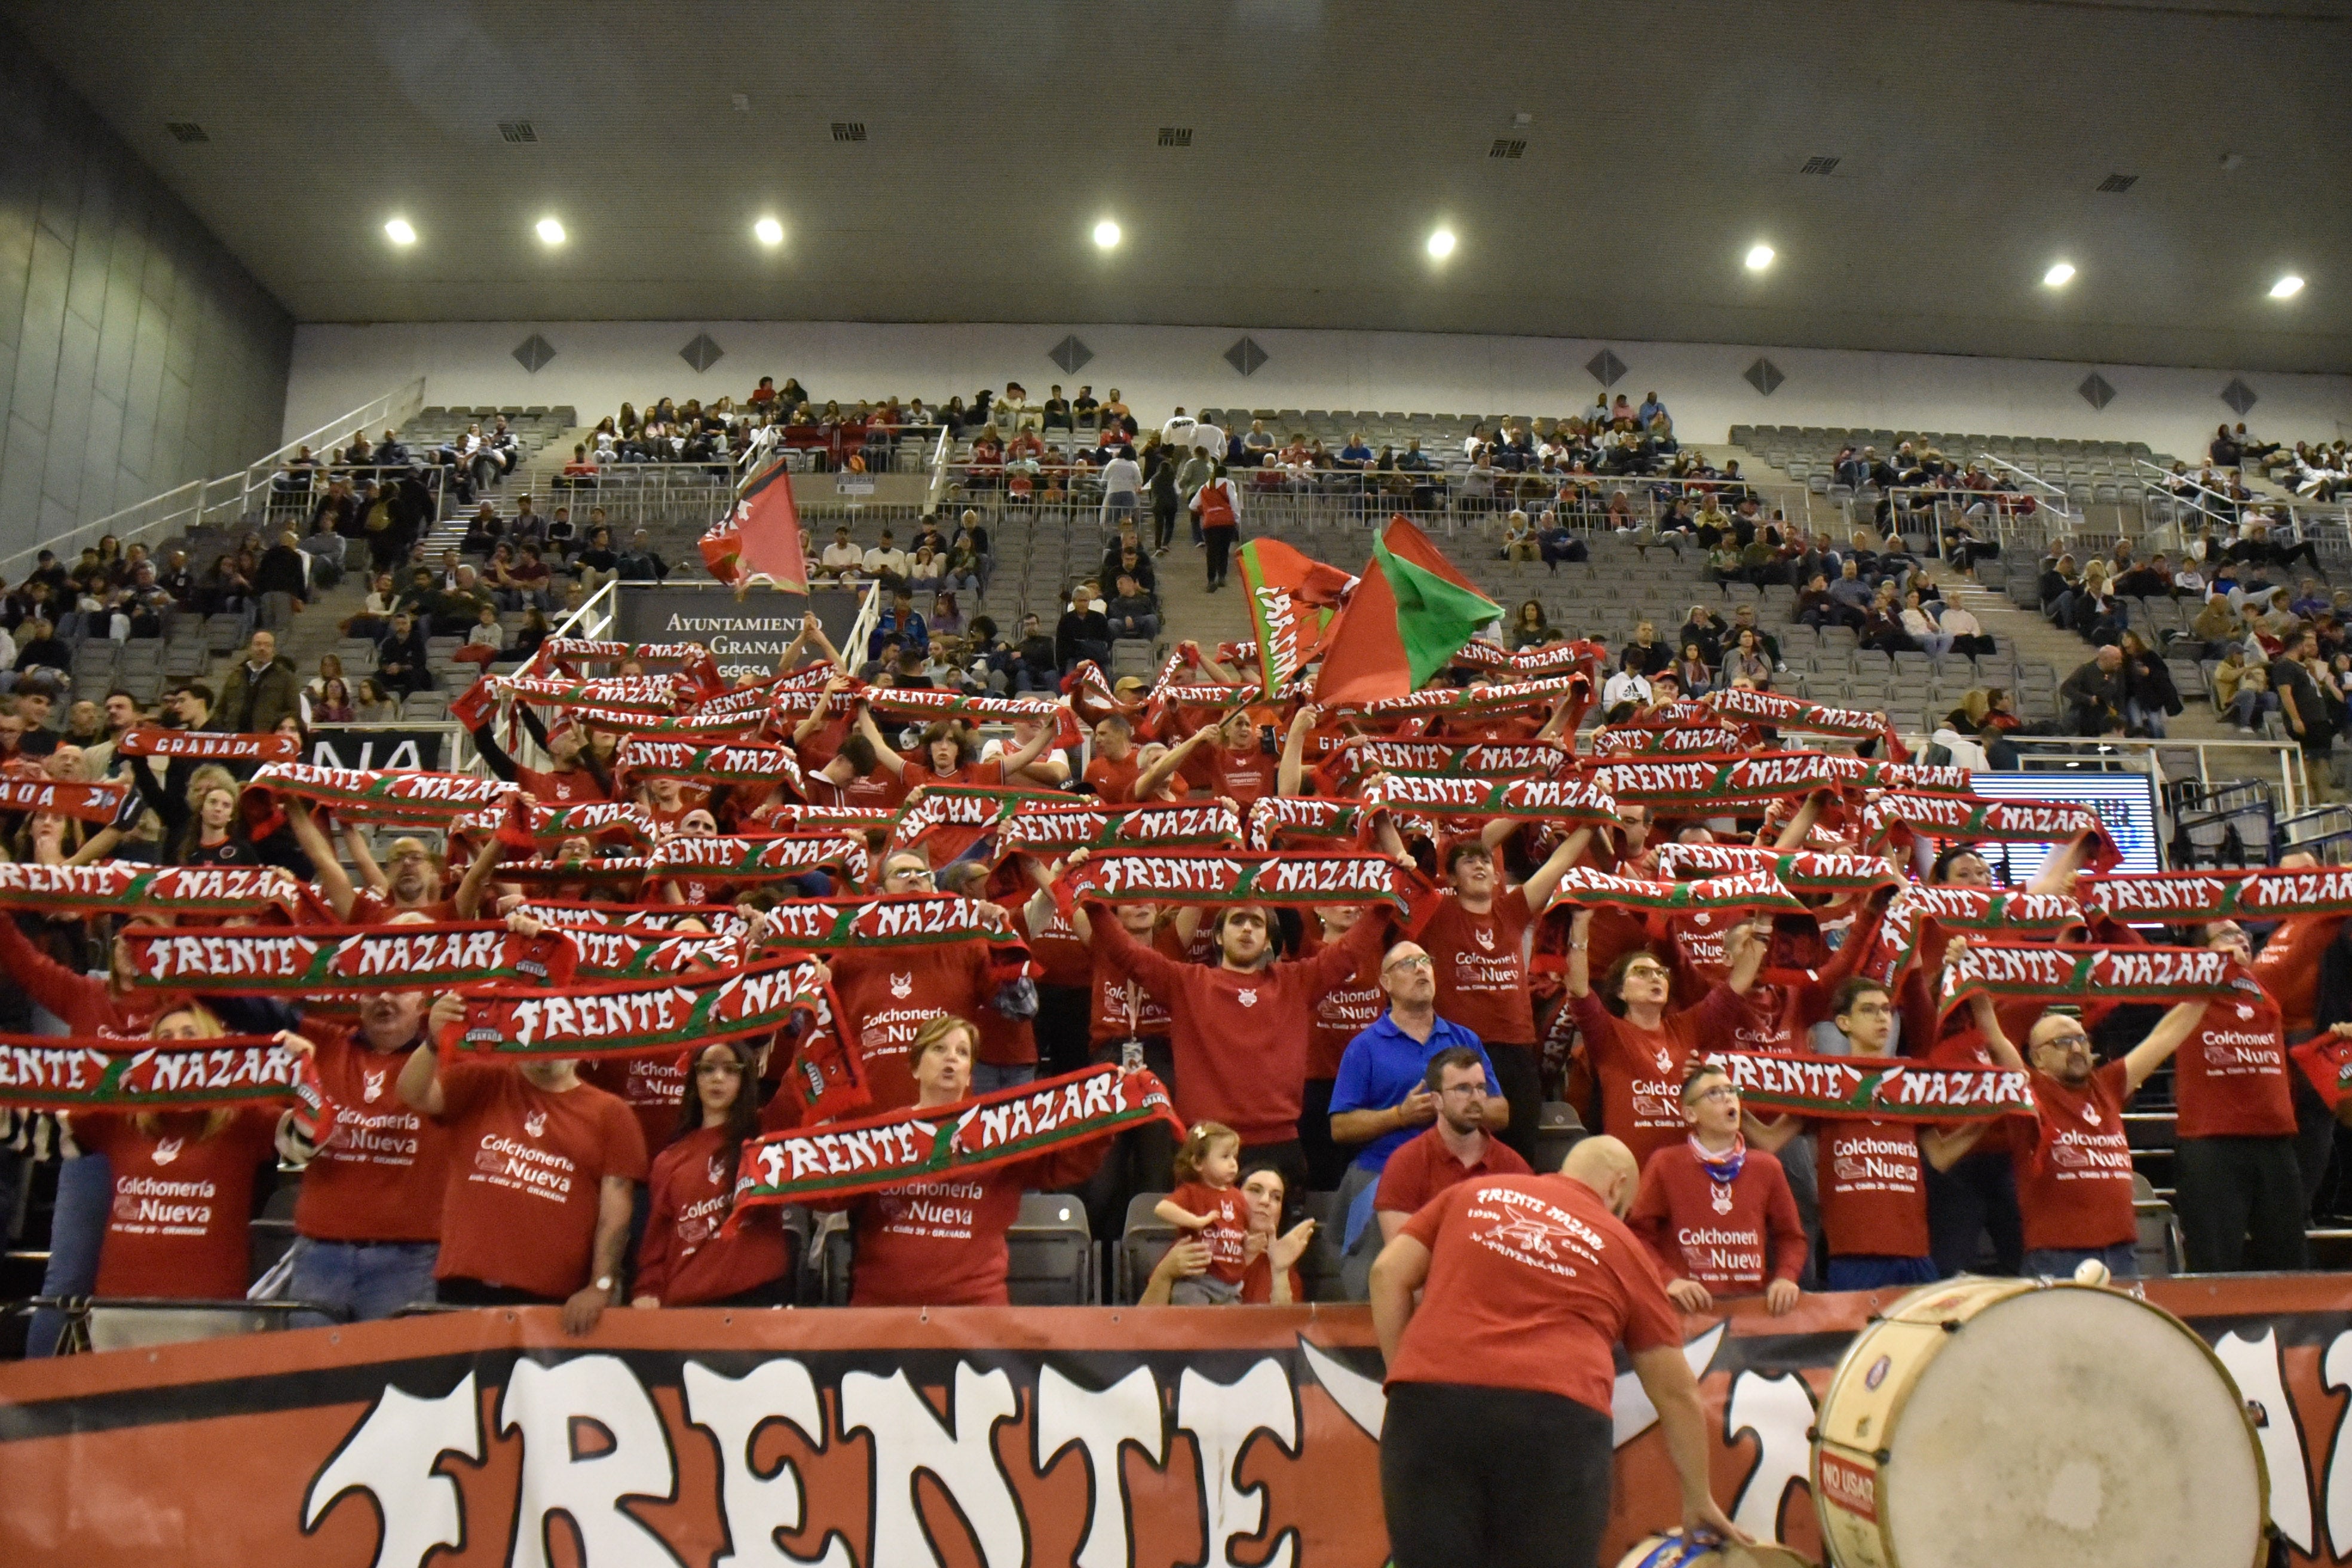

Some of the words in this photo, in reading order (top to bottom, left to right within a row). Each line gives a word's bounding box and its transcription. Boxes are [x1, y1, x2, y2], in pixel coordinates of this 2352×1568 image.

[867, 688, 950, 708] FRENTE
[1716, 690, 1790, 719] FRENTE
[155, 737, 261, 755] GRANADA
[1100, 857, 1225, 894] FRENTE
[2093, 877, 2211, 915] FRENTE
[146, 936, 298, 981] FRENTE
[511, 987, 676, 1049] FRENTE
[350, 1128, 417, 1154] Nueva
[758, 1123, 918, 1190] FRENTE
[504, 1157, 572, 1193] Nueva
[139, 1198, 213, 1223] Nueva
[1477, 1187, 1546, 1214] FRENTE
[1823, 1462, 1840, 1490] NO
